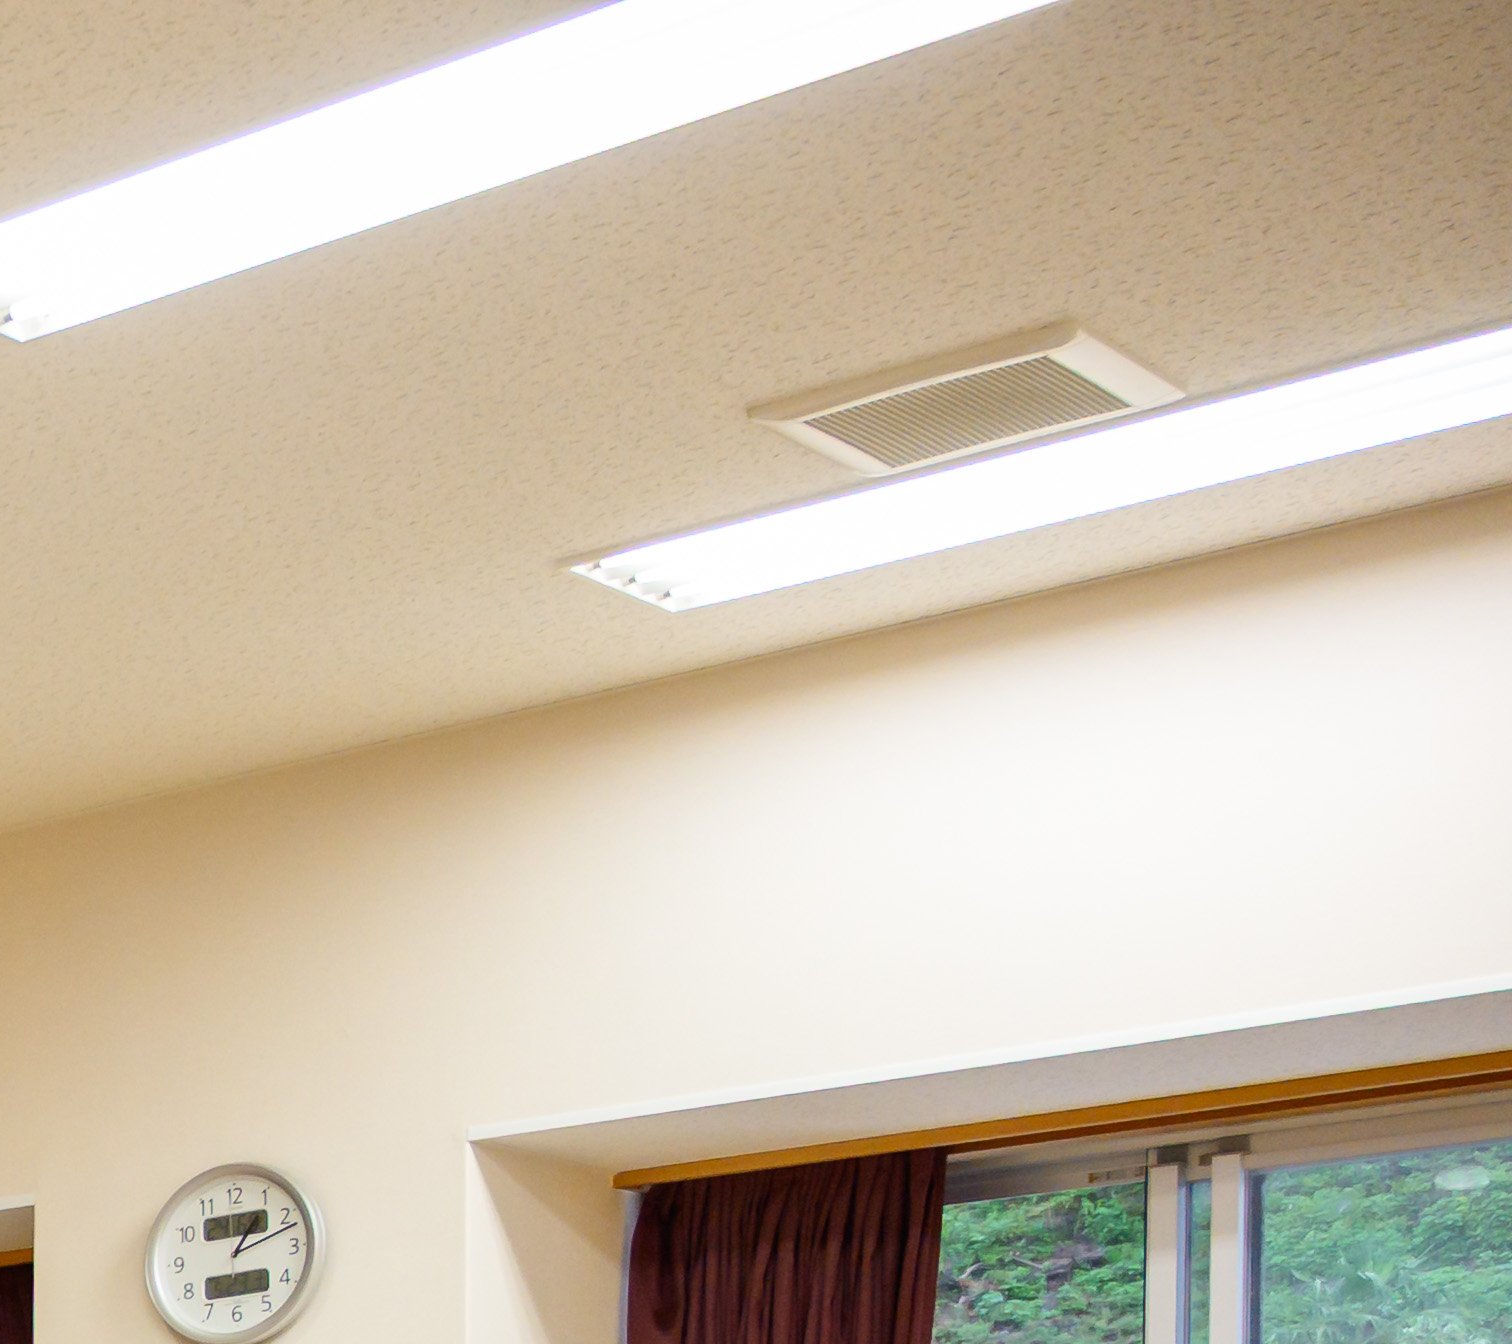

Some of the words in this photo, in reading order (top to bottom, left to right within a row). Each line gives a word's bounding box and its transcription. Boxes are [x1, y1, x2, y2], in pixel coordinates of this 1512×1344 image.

[226, 1187, 243, 1205] 12
[261, 1189, 268, 1205] 1
[200, 1199, 214, 1216] 11
[280, 1208, 291, 1225] 2
[179, 1226, 195, 1243] 10
[289, 1238, 299, 1255] 3
[174, 1257, 185, 1273] 9
[279, 1269, 291, 1284] 4
[183, 1283, 194, 1300] 8
[204, 1303, 214, 1320] 7
[261, 1295, 272, 1312] 5
[232, 1305, 243, 1322] 6
